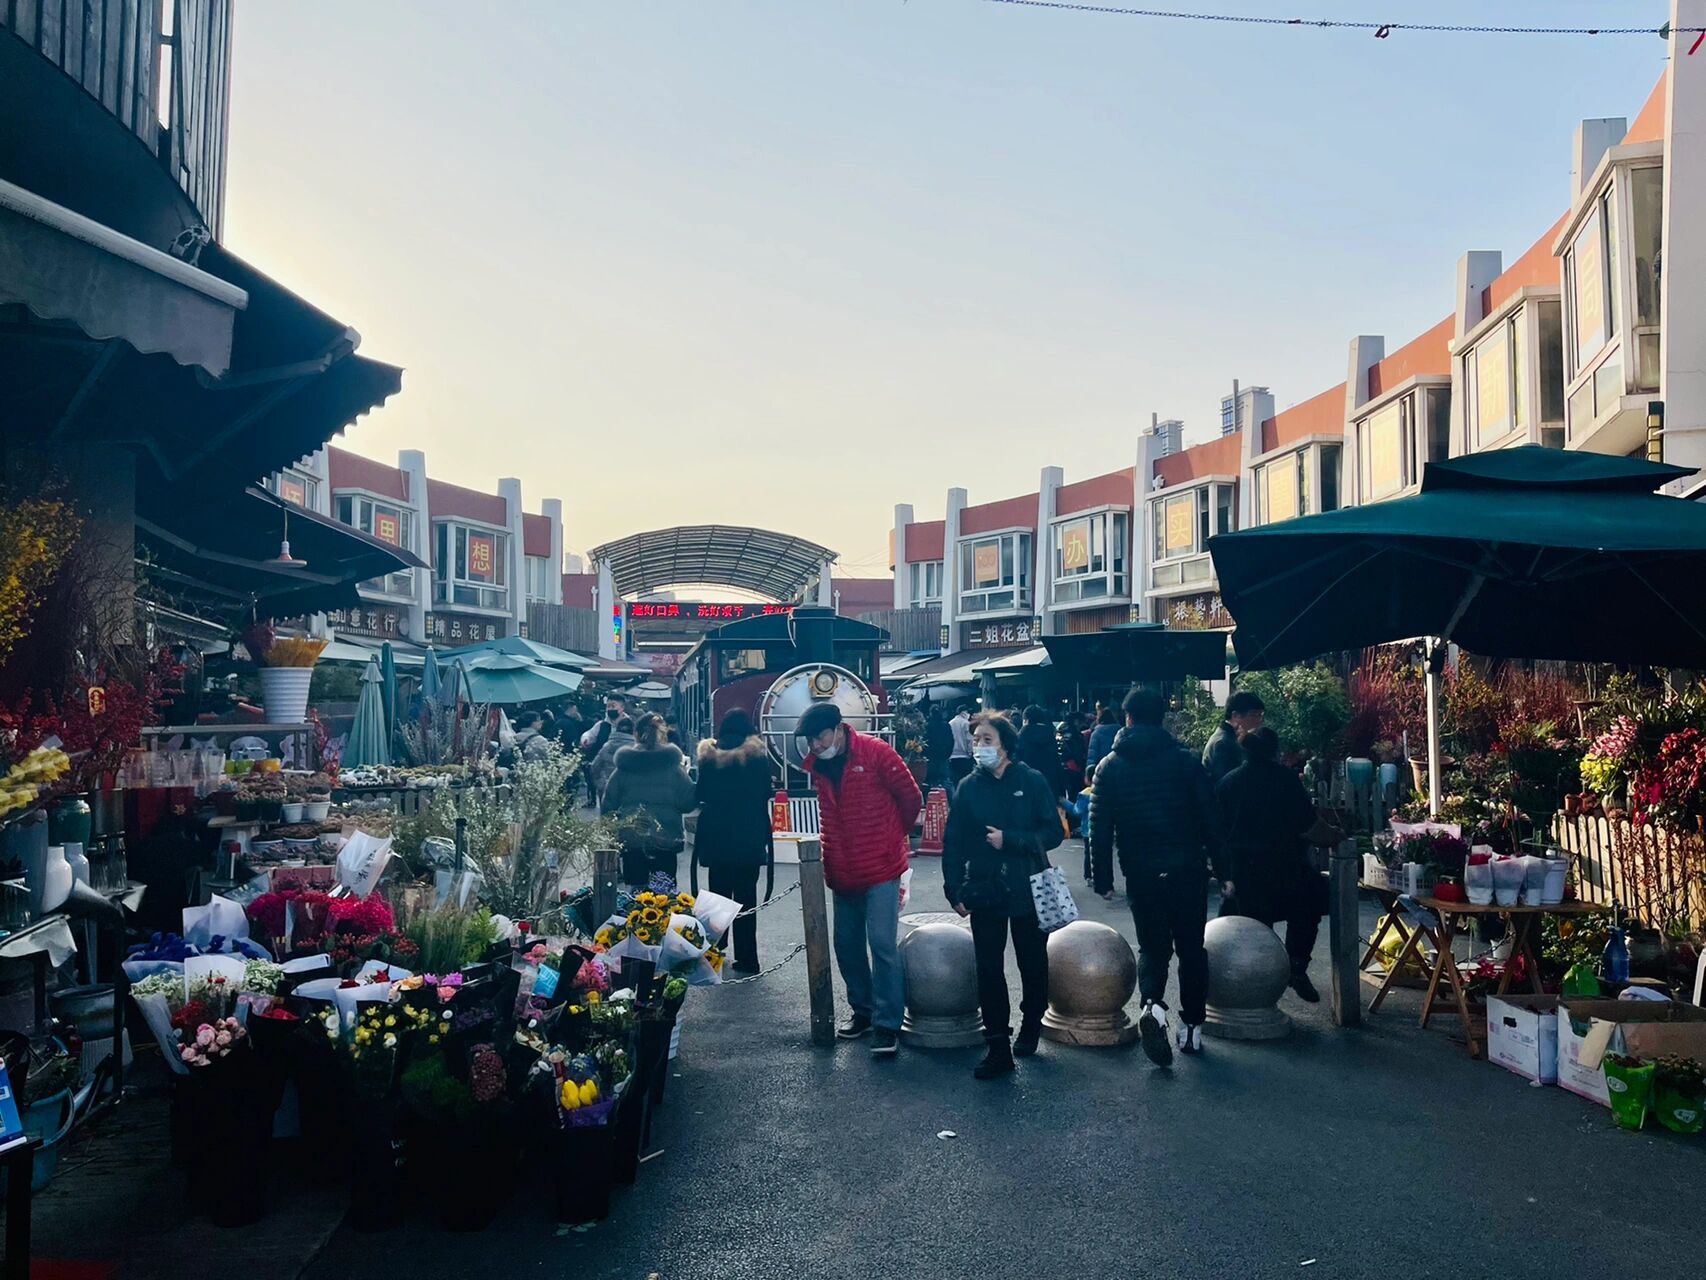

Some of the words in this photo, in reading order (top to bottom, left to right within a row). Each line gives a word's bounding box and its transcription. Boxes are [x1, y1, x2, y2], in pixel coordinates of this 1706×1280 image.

[1170, 508, 1189, 543] 实
[472, 542, 490, 571] 想
[1067, 533, 1085, 564] 办
[969, 622, 1030, 644] 二姐花盆
